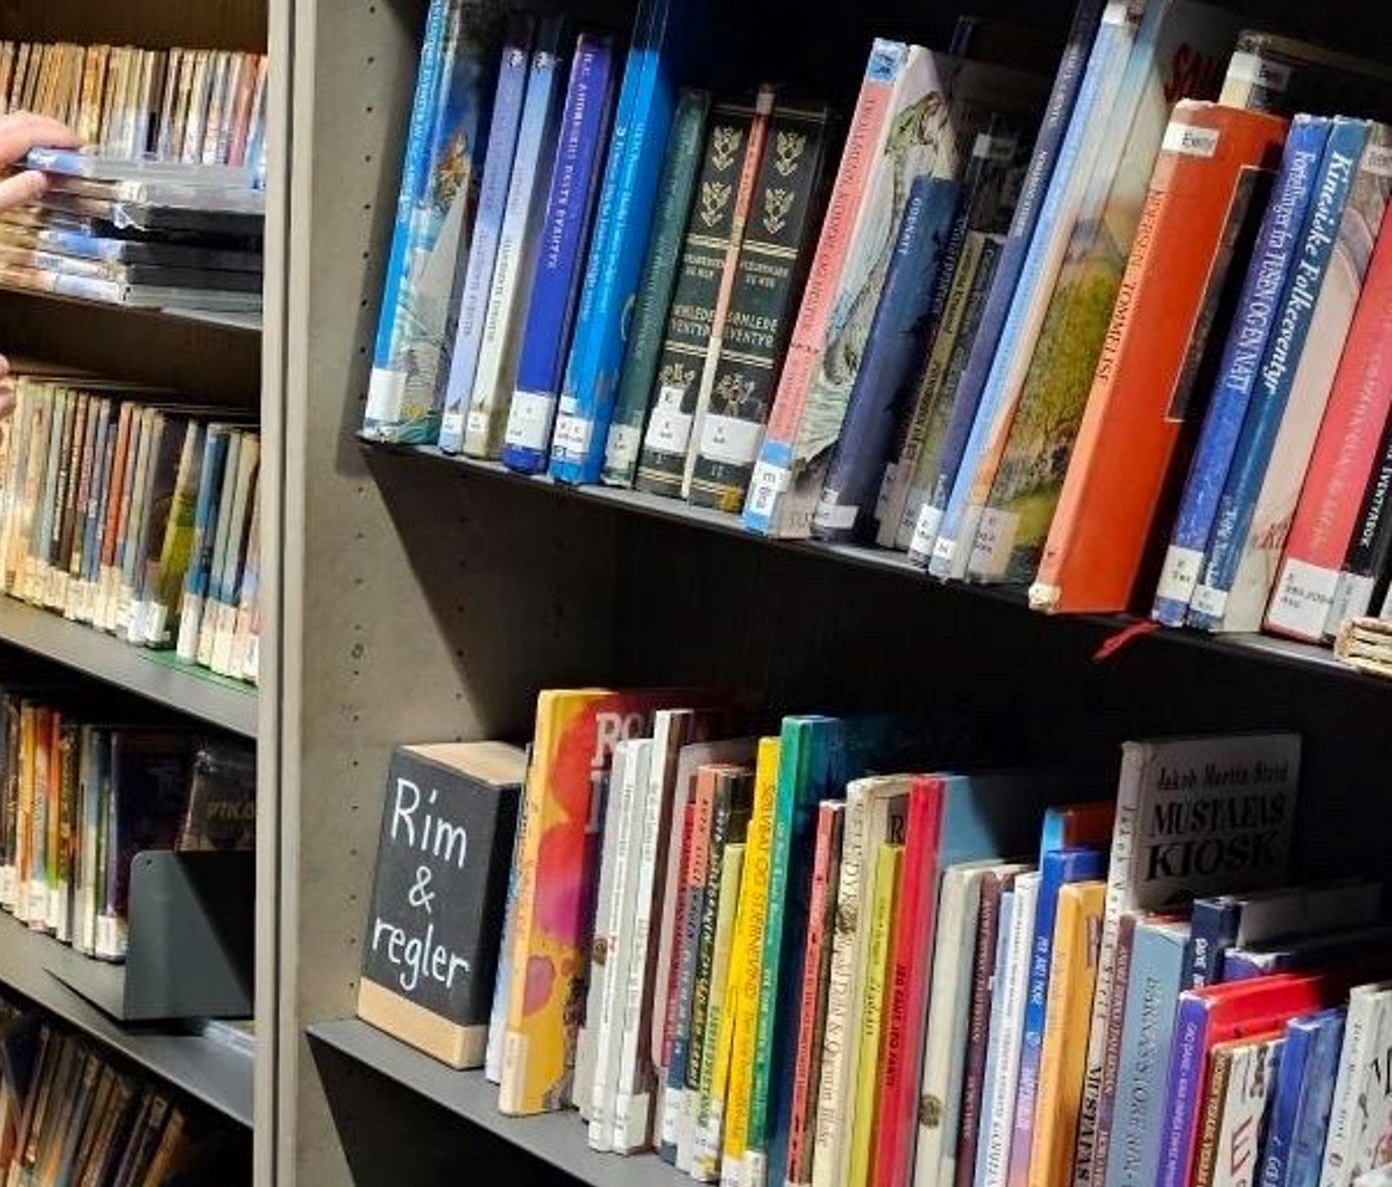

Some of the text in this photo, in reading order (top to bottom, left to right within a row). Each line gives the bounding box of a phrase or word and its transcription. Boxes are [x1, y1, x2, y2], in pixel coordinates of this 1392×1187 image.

[1224, 147, 1316, 394] Fortellinger fra TUSEN OG EN NATT
[1258, 150, 1356, 396] Kinesiske Folkeeventyr
[1093, 280, 1138, 385] TOMMELISE
[391, 778, 467, 869] Rim
[1145, 828, 1281, 882] KIOSK
[1151, 794, 1285, 839] MUSTAFAS
[408, 866, 436, 912] &
[371, 918, 470, 991] regler
[1074, 1064, 1104, 1182] MUSTAFAS
